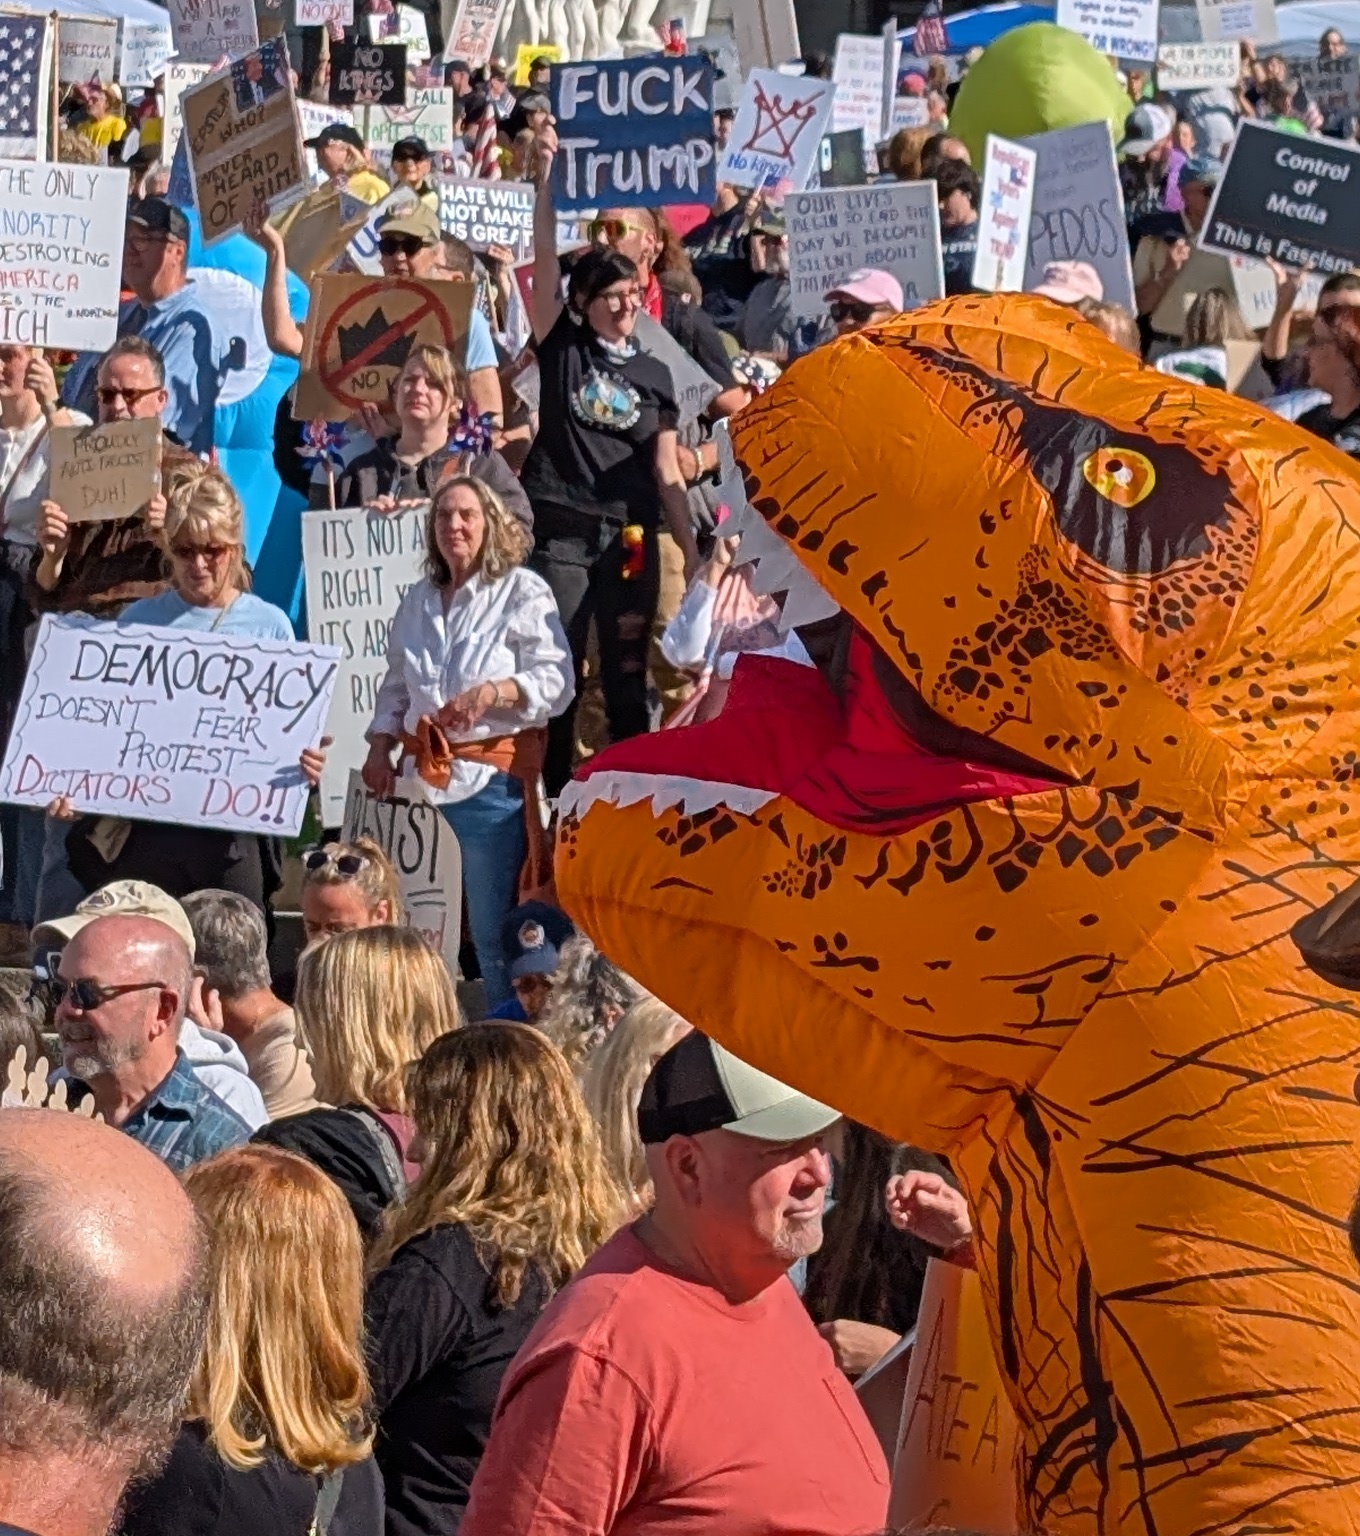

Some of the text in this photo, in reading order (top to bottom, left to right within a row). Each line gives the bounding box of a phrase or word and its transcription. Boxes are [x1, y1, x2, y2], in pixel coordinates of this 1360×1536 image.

[355, 47, 385, 68] NO
[213, 152, 280, 196] HEARD
[1275, 147, 1351, 182] Control
[45, 168, 99, 202] ONLY
[441, 182, 533, 211] HATE WILL
[1293, 178, 1318, 197] of
[208, 193, 241, 228] OF
[441, 203, 534, 229] NOT MAKE
[797, 190, 893, 215] OUR LIVES
[1266, 193, 1328, 225] Media
[471, 225, 534, 248] GREAT
[795, 237, 825, 255] DAY
[1029, 198, 1119, 270] PEDOS
[1214, 221, 1355, 273] This is Fascism
[796, 252, 853, 273] SILENT
[865, 244, 918, 265] ABOUT
[32, 293, 66, 308] THE
[351, 371, 380, 392] NO
[80, 477, 128, 511] DUH!
[321, 518, 356, 560] IT'S
[366, 516, 404, 558] NOT
[321, 566, 383, 610] RIGHT
[68, 638, 338, 734] DEMOCRACY
[35, 692, 268, 750] DOESN'T FEAR
[13, 753, 286, 825] DICTATORS DO!!
